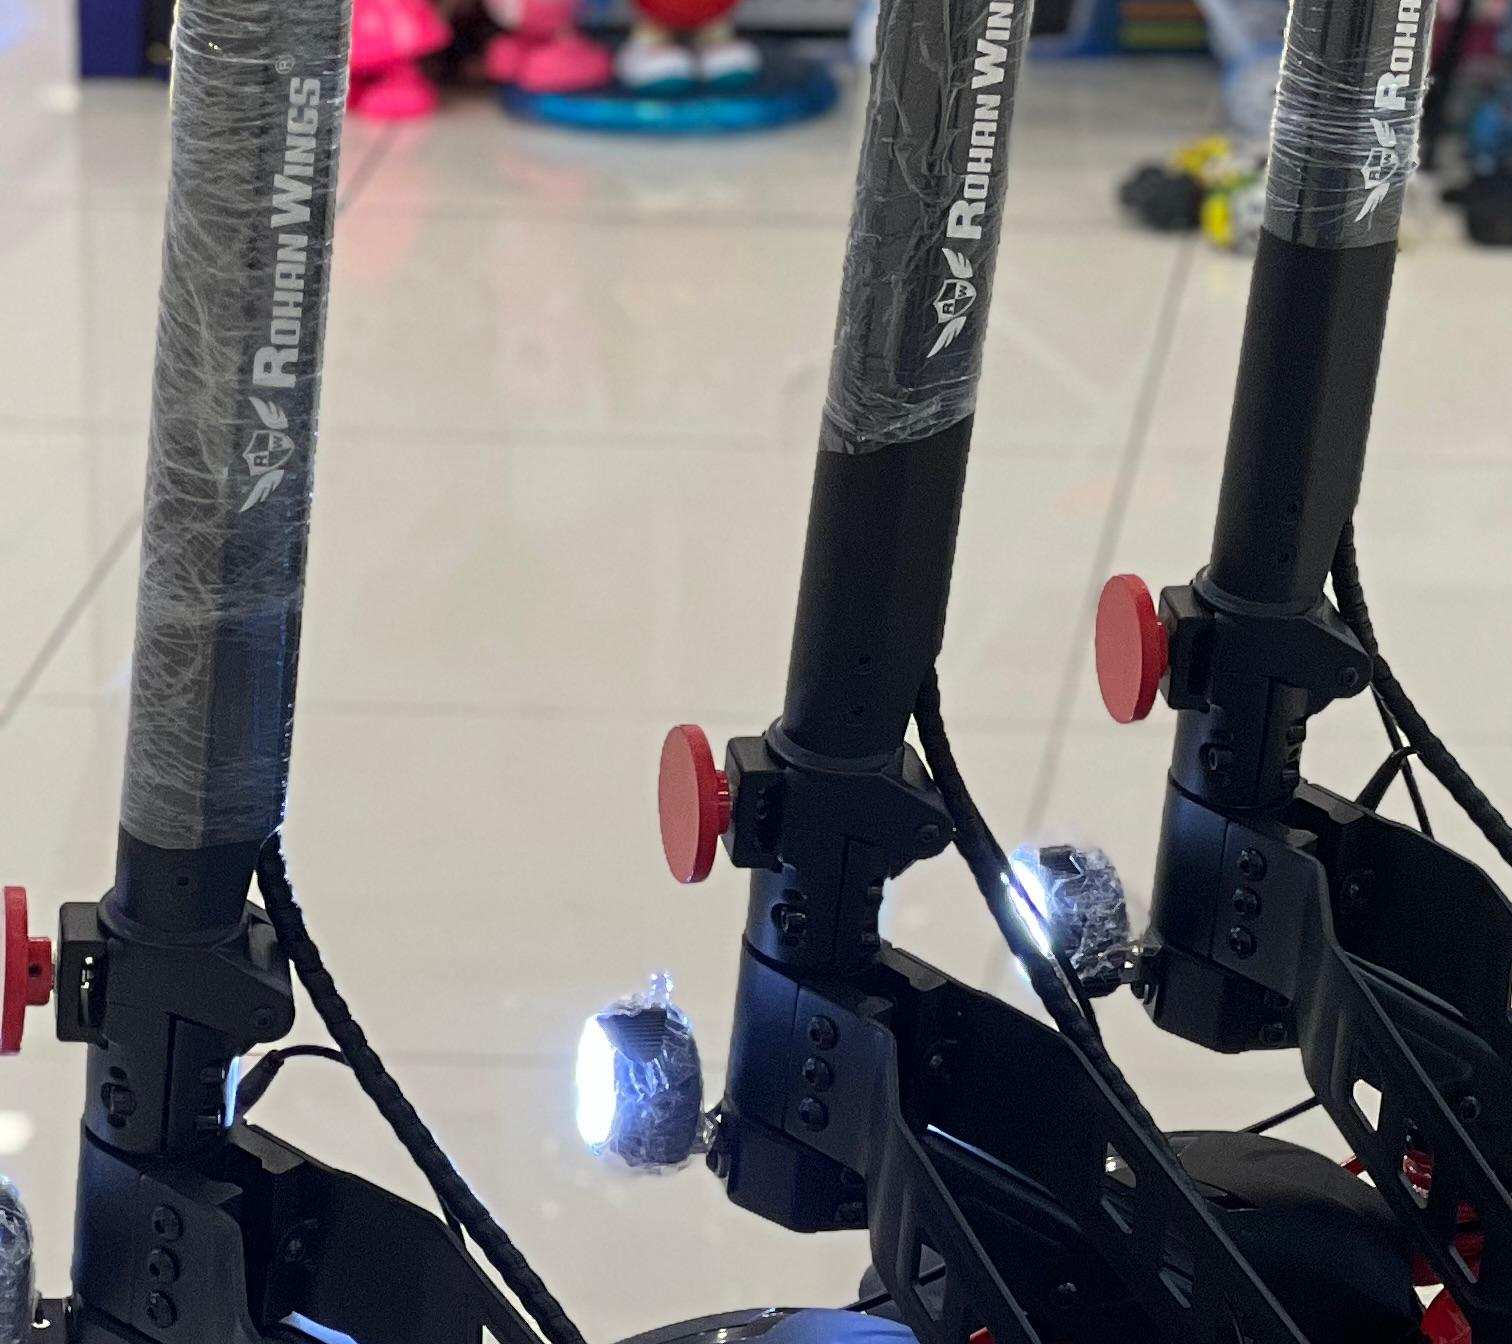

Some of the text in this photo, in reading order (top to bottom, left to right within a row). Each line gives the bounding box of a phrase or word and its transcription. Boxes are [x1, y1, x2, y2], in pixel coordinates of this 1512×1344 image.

[252, 76, 322, 388] ROHAN WINGS
[946, 94, 1002, 240] ROHAN
